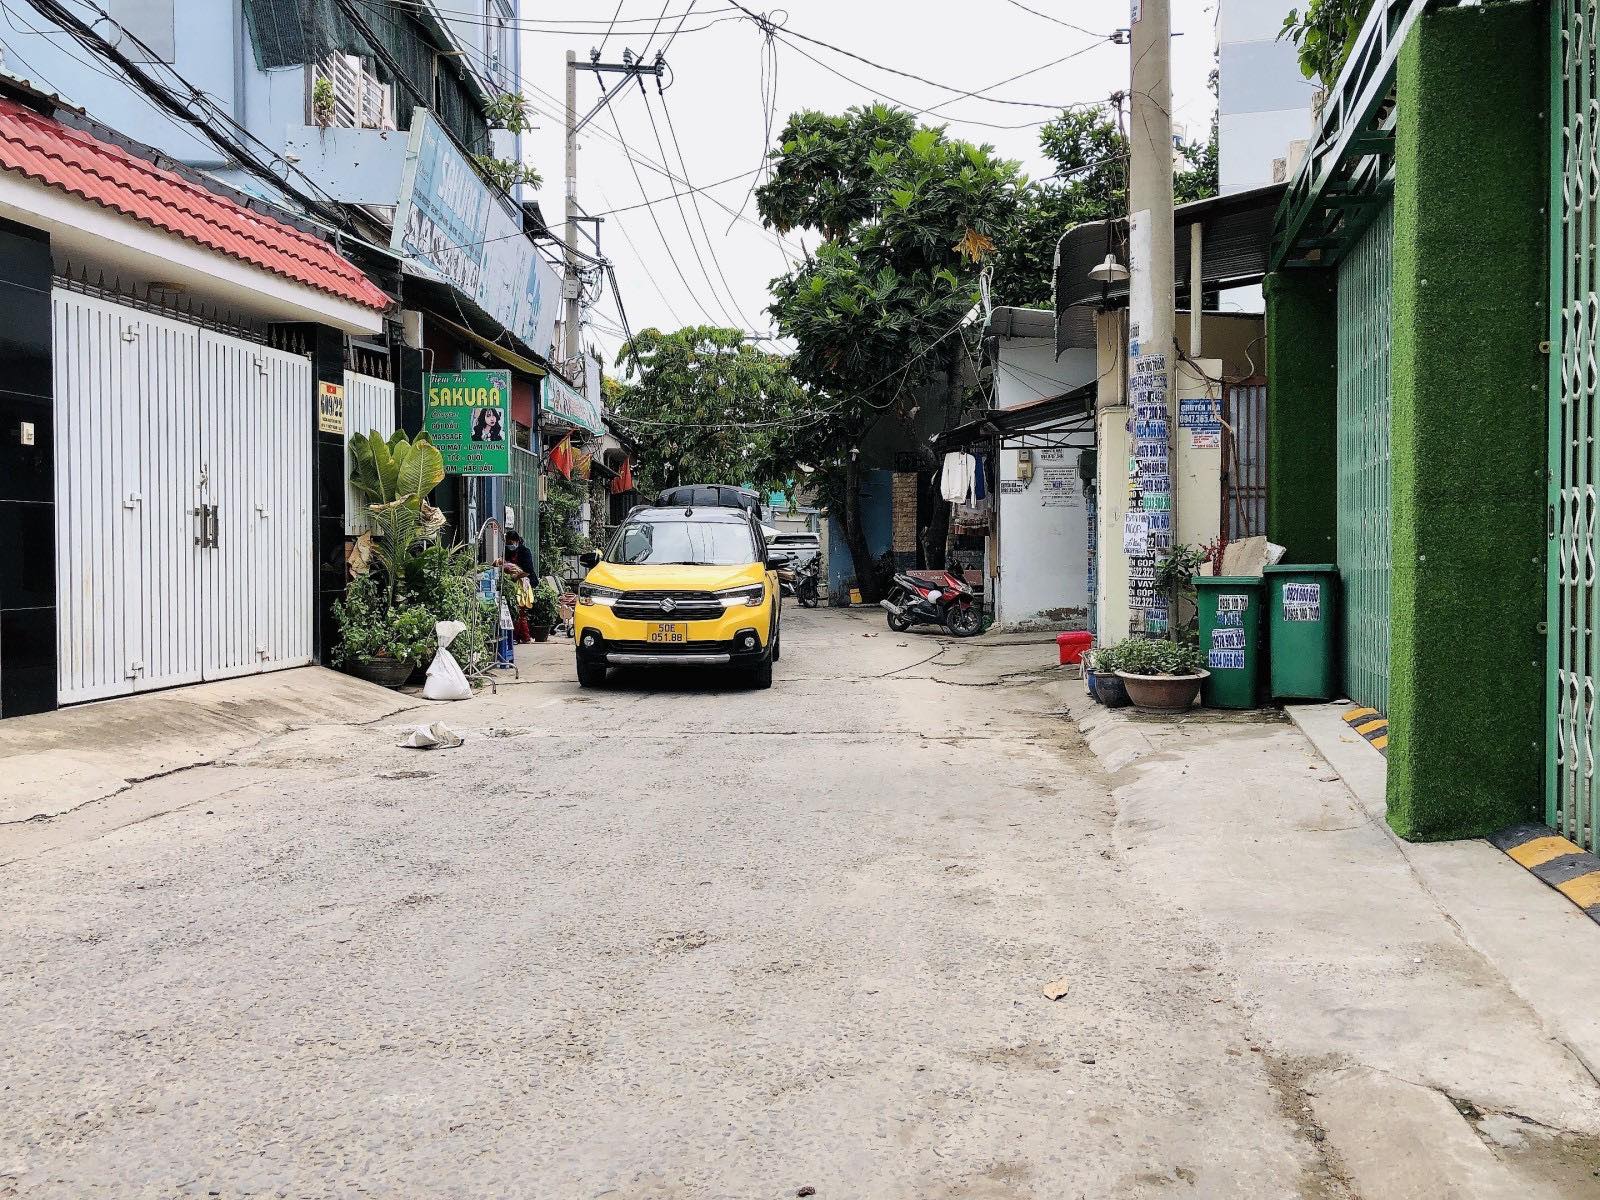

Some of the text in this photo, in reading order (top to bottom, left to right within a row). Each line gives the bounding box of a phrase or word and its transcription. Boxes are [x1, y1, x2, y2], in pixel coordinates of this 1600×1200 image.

[429, 387, 500, 407] SAKURA
[1137, 588, 1154, 597] GÓP
[658, 624, 676, 632] 50E
[651, 633, 683, 641] 051.88
